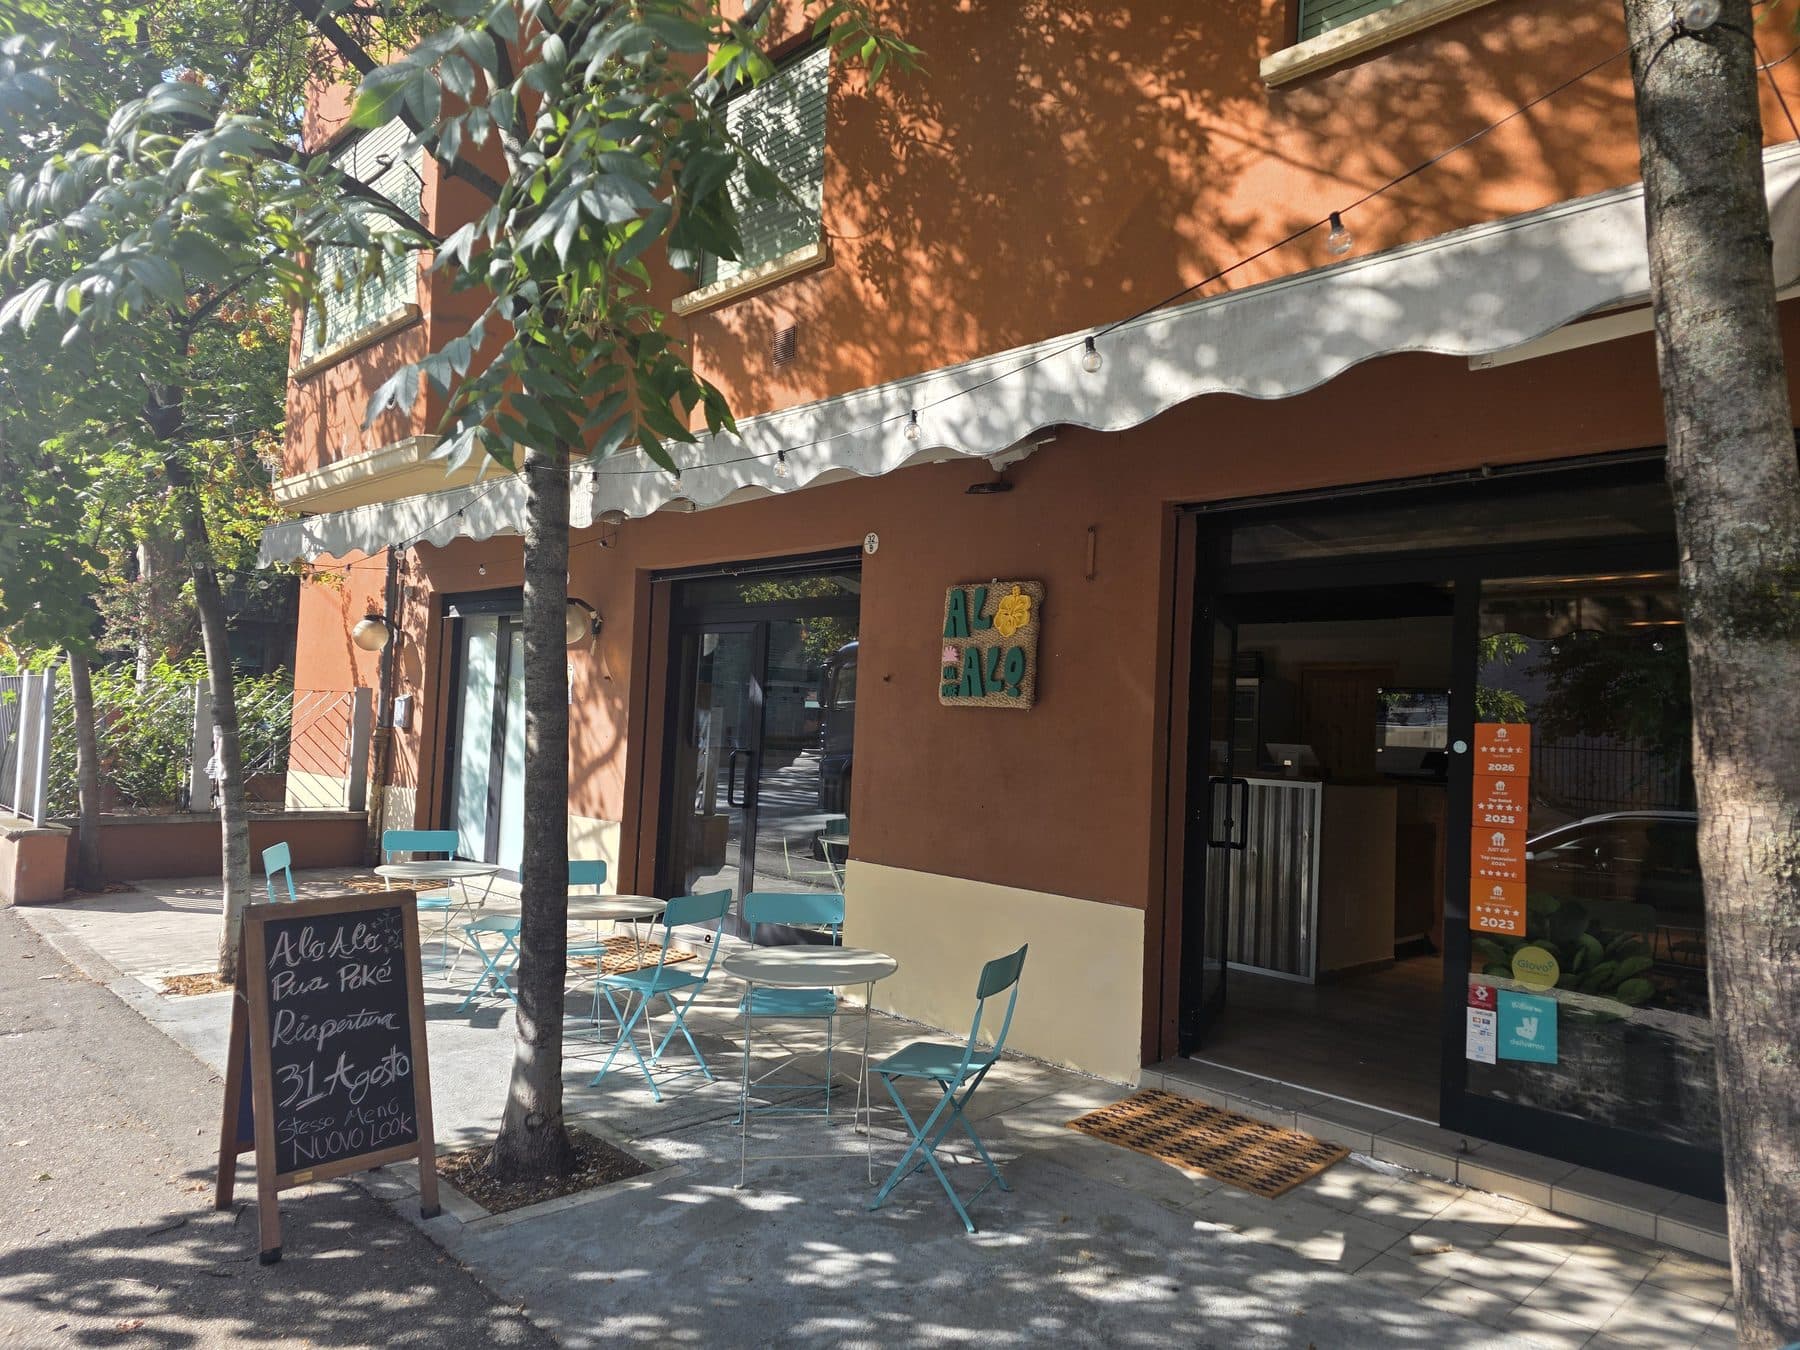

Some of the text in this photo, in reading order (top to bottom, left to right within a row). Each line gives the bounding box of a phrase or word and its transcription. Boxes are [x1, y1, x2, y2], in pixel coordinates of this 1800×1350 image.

[1485, 814, 1515, 824] 2025
[1480, 917, 1515, 930] 2023
[268, 921, 383, 970] Alo Alo
[1518, 959, 1549, 973] Glovo
[271, 970, 328, 1001] Pua
[271, 1008, 400, 1052] Riapertura
[276, 1044, 410, 1110] 31 Agosto
[293, 1112, 413, 1165] NUOVO LOOK
